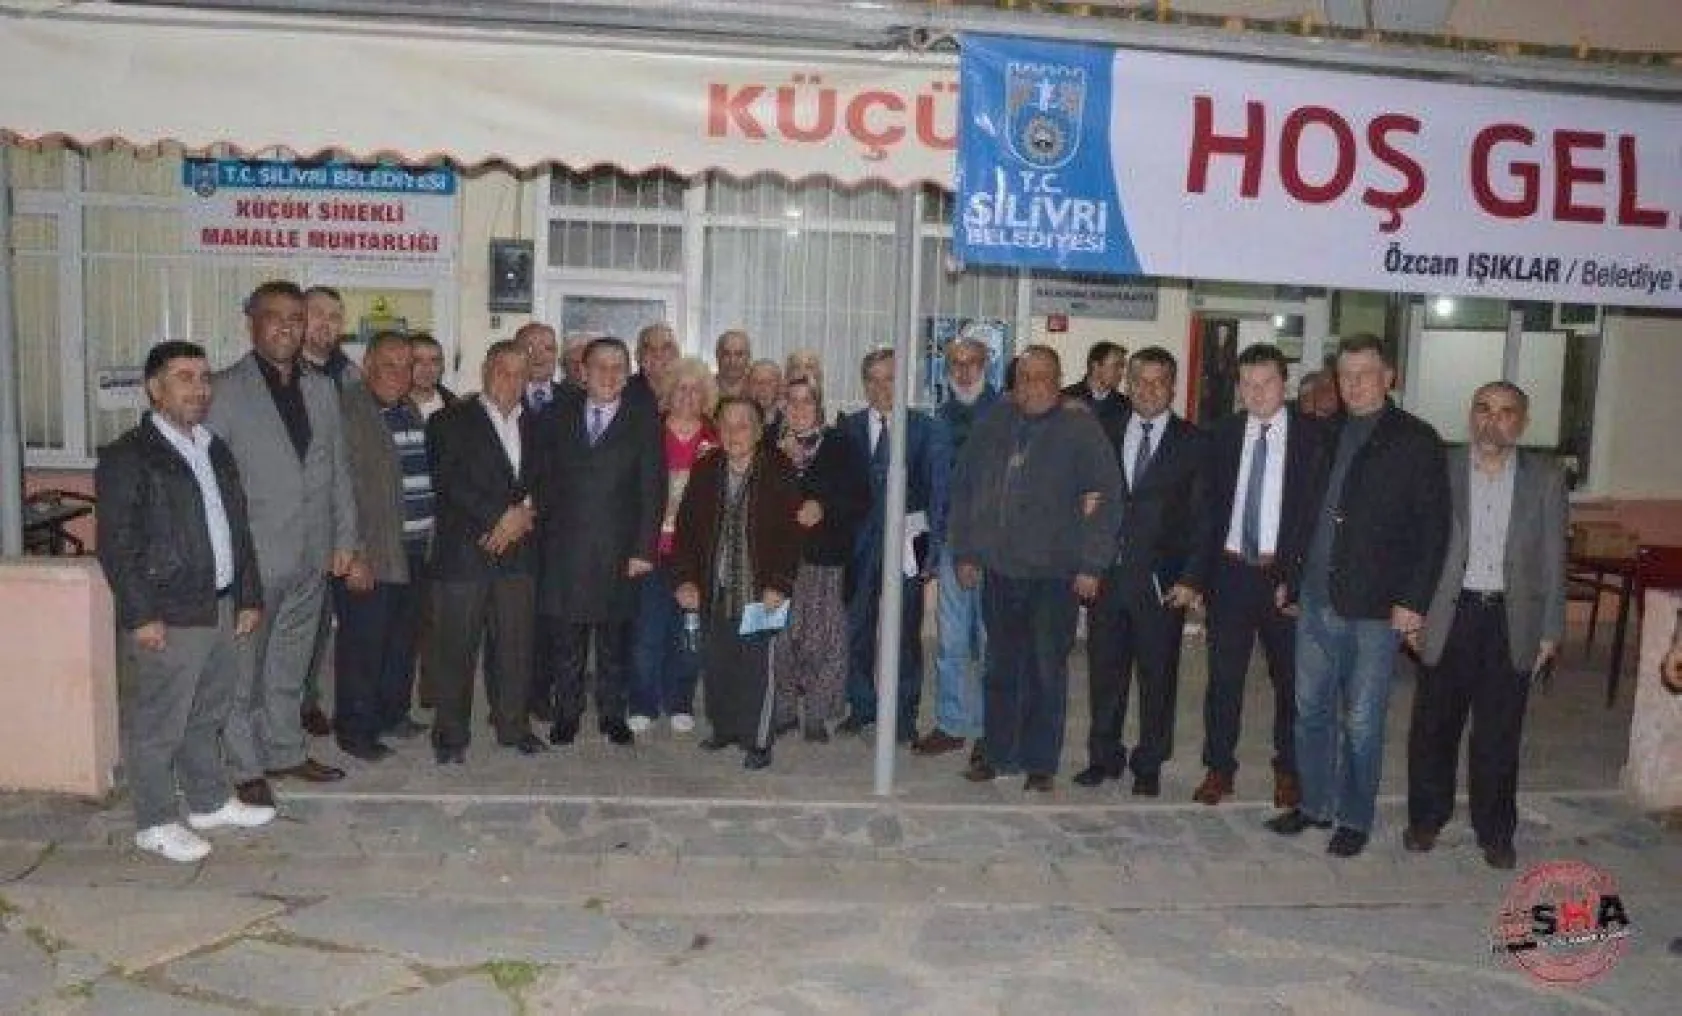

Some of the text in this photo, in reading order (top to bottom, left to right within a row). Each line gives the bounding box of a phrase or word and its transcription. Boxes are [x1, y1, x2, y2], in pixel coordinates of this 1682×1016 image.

[1187, 96, 1682, 233] HOŞ GEL
[236, 196, 404, 224] KÜÇÜK SİNEKLİ
[202, 228, 440, 253] MAHALLE MUHTARLIĞI
[1384, 242, 1459, 276] Özcan
[1466, 252, 1560, 286] IŞIKLAR
[1565, 257, 1578, 285] /
[1581, 260, 1673, 295] Belediye
